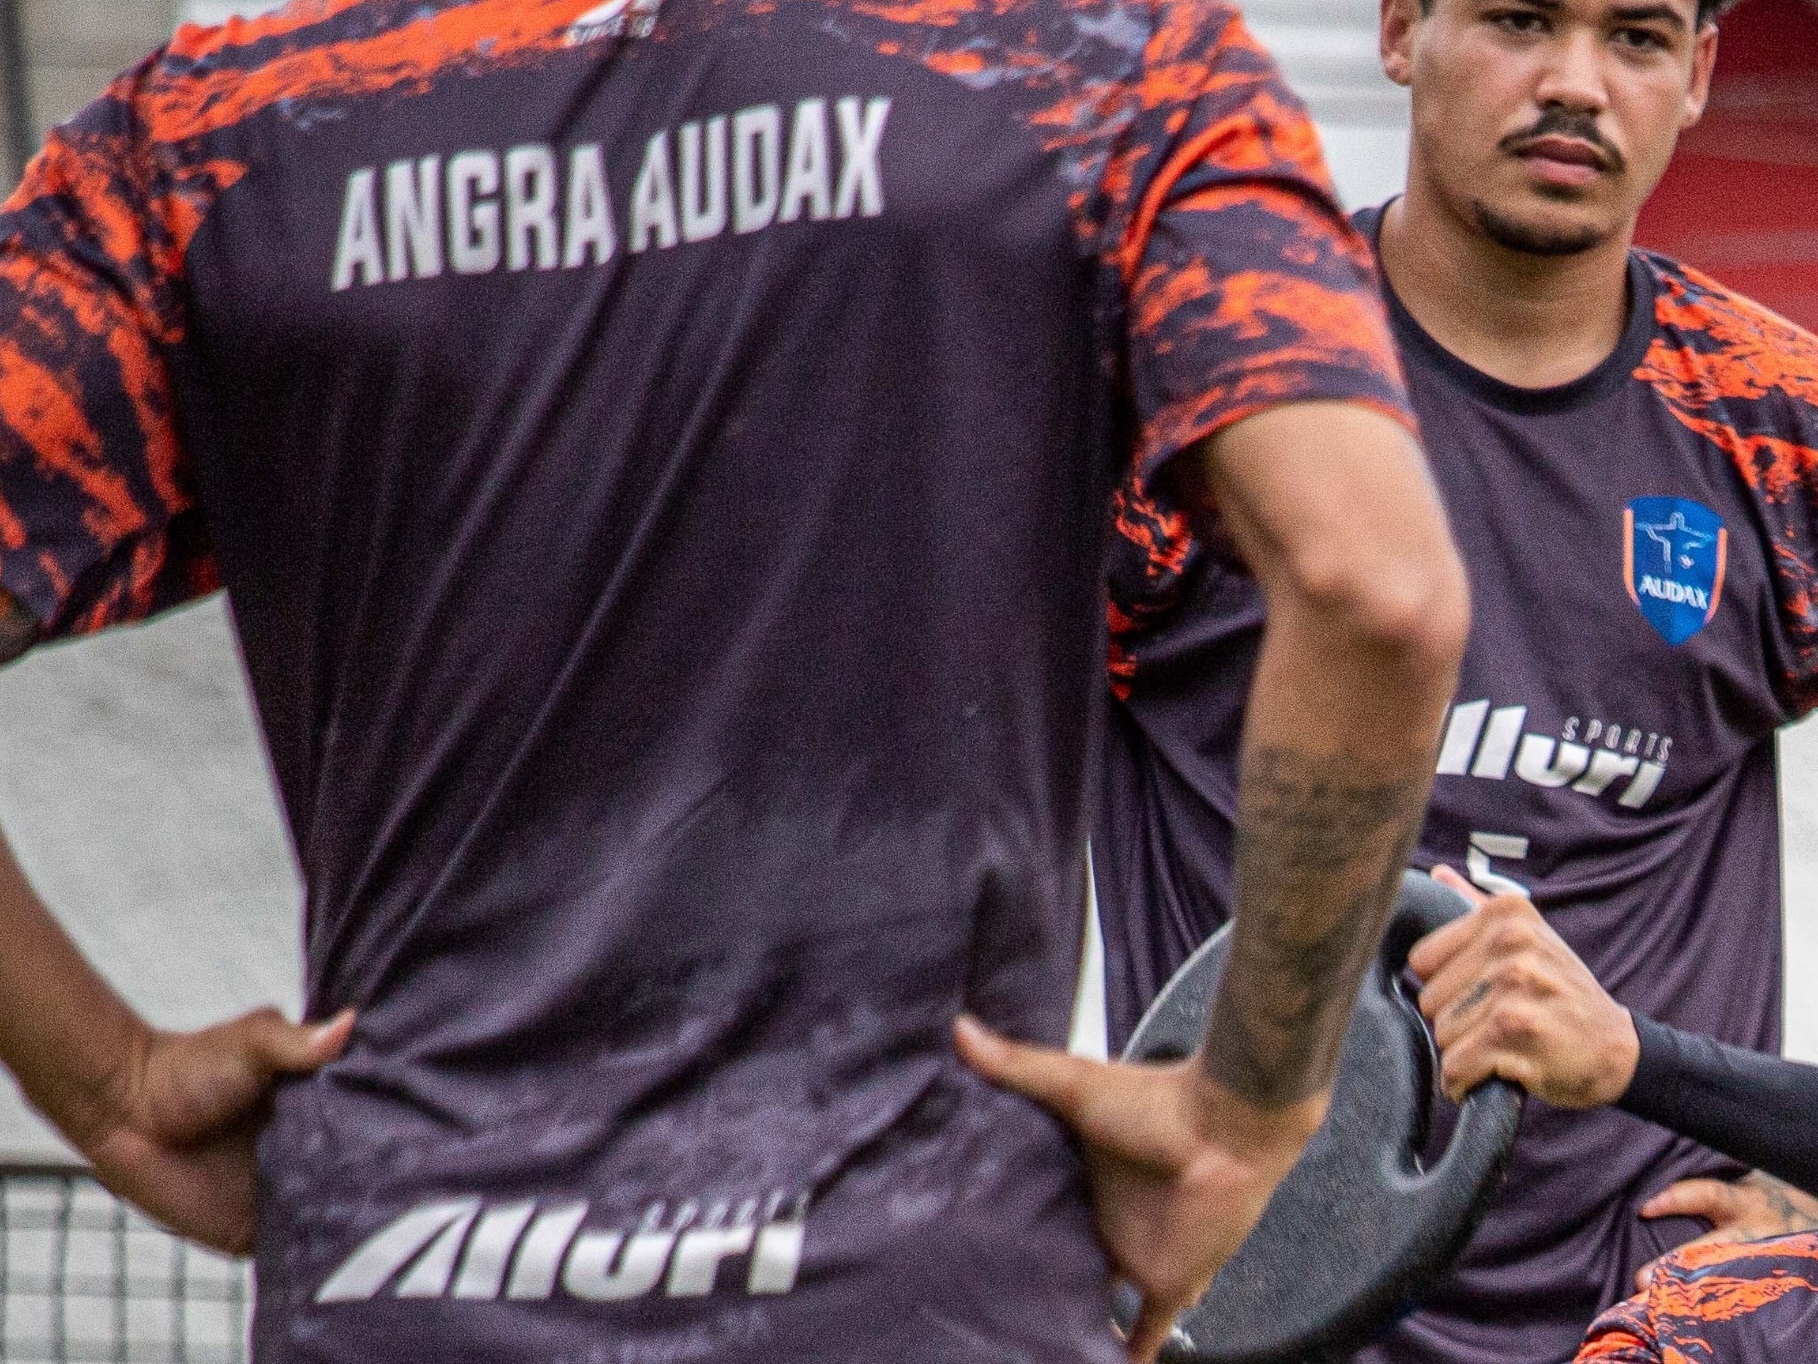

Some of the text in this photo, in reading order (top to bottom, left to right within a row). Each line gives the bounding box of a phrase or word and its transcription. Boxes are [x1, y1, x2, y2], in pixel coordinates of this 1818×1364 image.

[331, 97, 892, 291] ANGRA AUDAX
[1639, 576, 1707, 610] AUDAX
[1562, 717, 1673, 761] SPORTS
